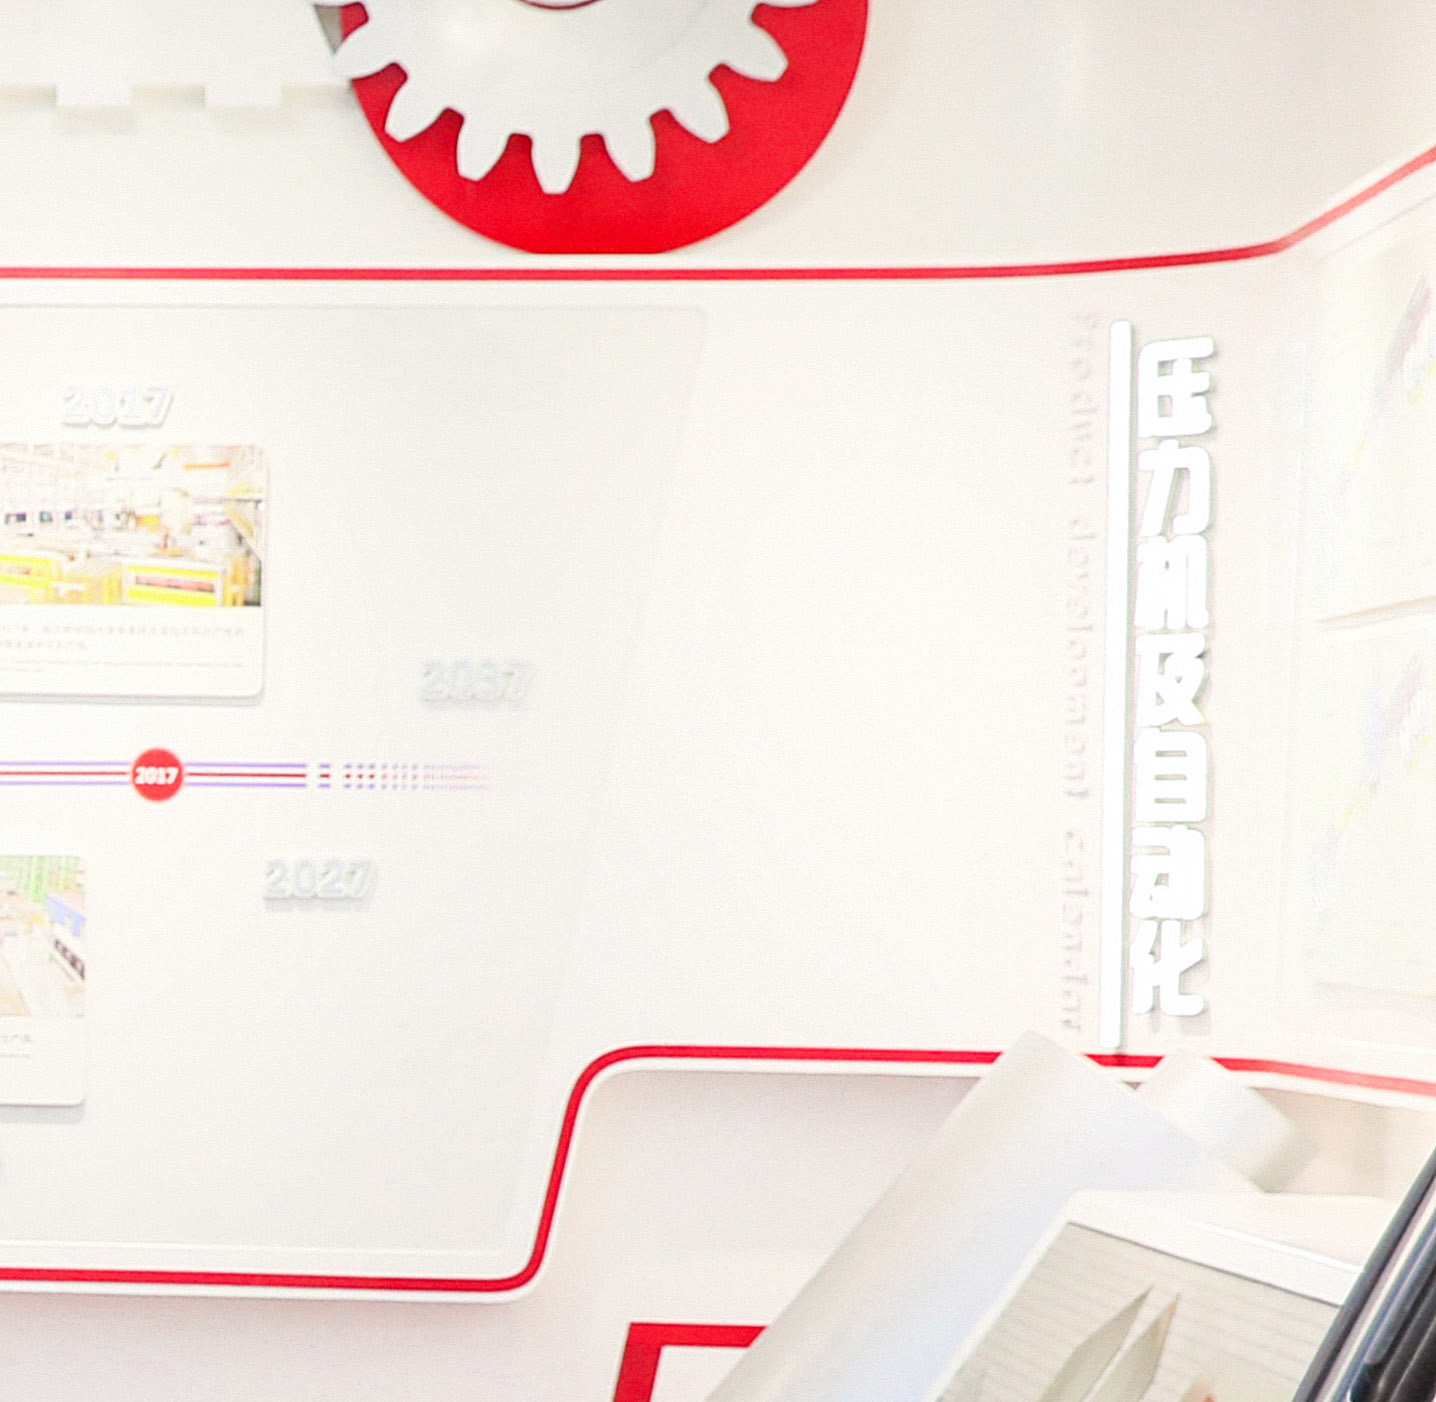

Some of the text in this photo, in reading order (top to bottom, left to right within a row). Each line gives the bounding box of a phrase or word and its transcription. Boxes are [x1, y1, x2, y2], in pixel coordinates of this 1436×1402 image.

[61, 383, 173, 426] 2017
[420, 659, 531, 702] 2037
[1128, 336, 1215, 1017] 压力机及自动化
[135, 765, 178, 786] 2017
[264, 860, 375, 901] 2027
